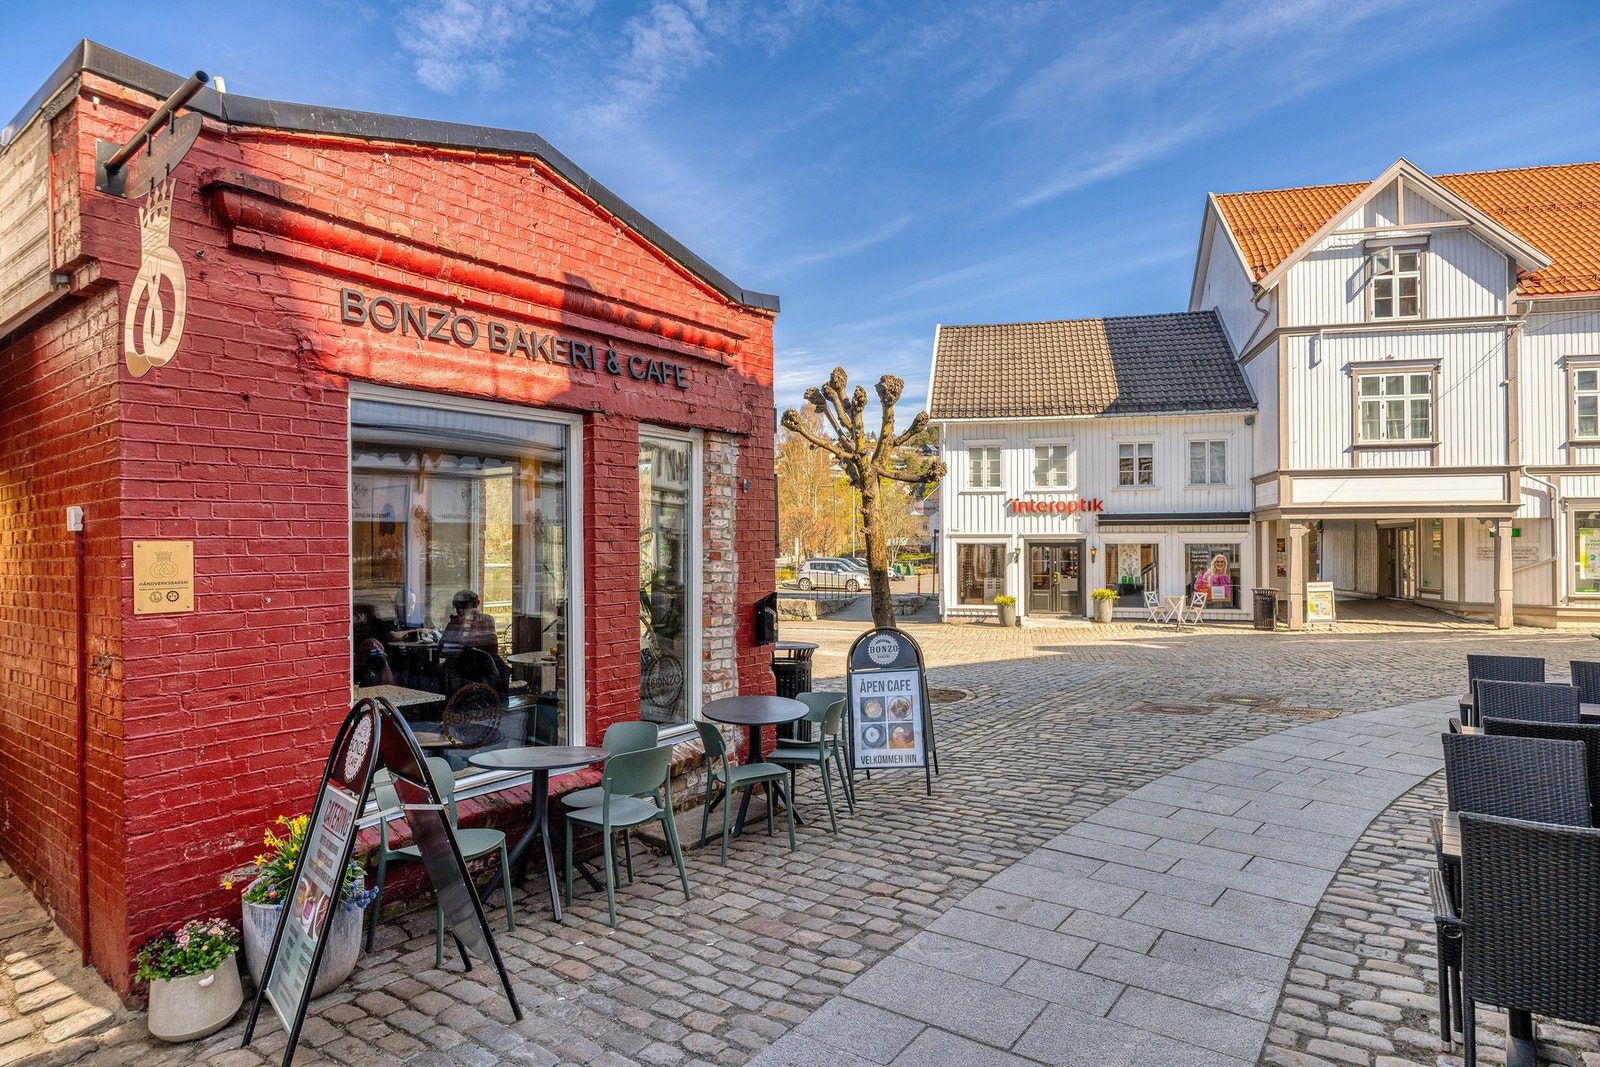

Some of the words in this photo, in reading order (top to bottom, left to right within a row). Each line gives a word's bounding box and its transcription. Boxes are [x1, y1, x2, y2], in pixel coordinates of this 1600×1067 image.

[341, 287, 479, 347] BONZO
[488, 321, 597, 370] BAKERI
[606, 349, 622, 375] &
[628, 355, 690, 389] CAFE
[1008, 498, 1104, 516] interoptik
[869, 645, 898, 654] BONZO
[651, 674, 680, 689] BONZO
[860, 679, 885, 693] ÅPEN
[887, 679, 911, 692] CAFE
[861, 755, 903, 765] VELKOMMEN
[904, 754, 917, 763] INN
